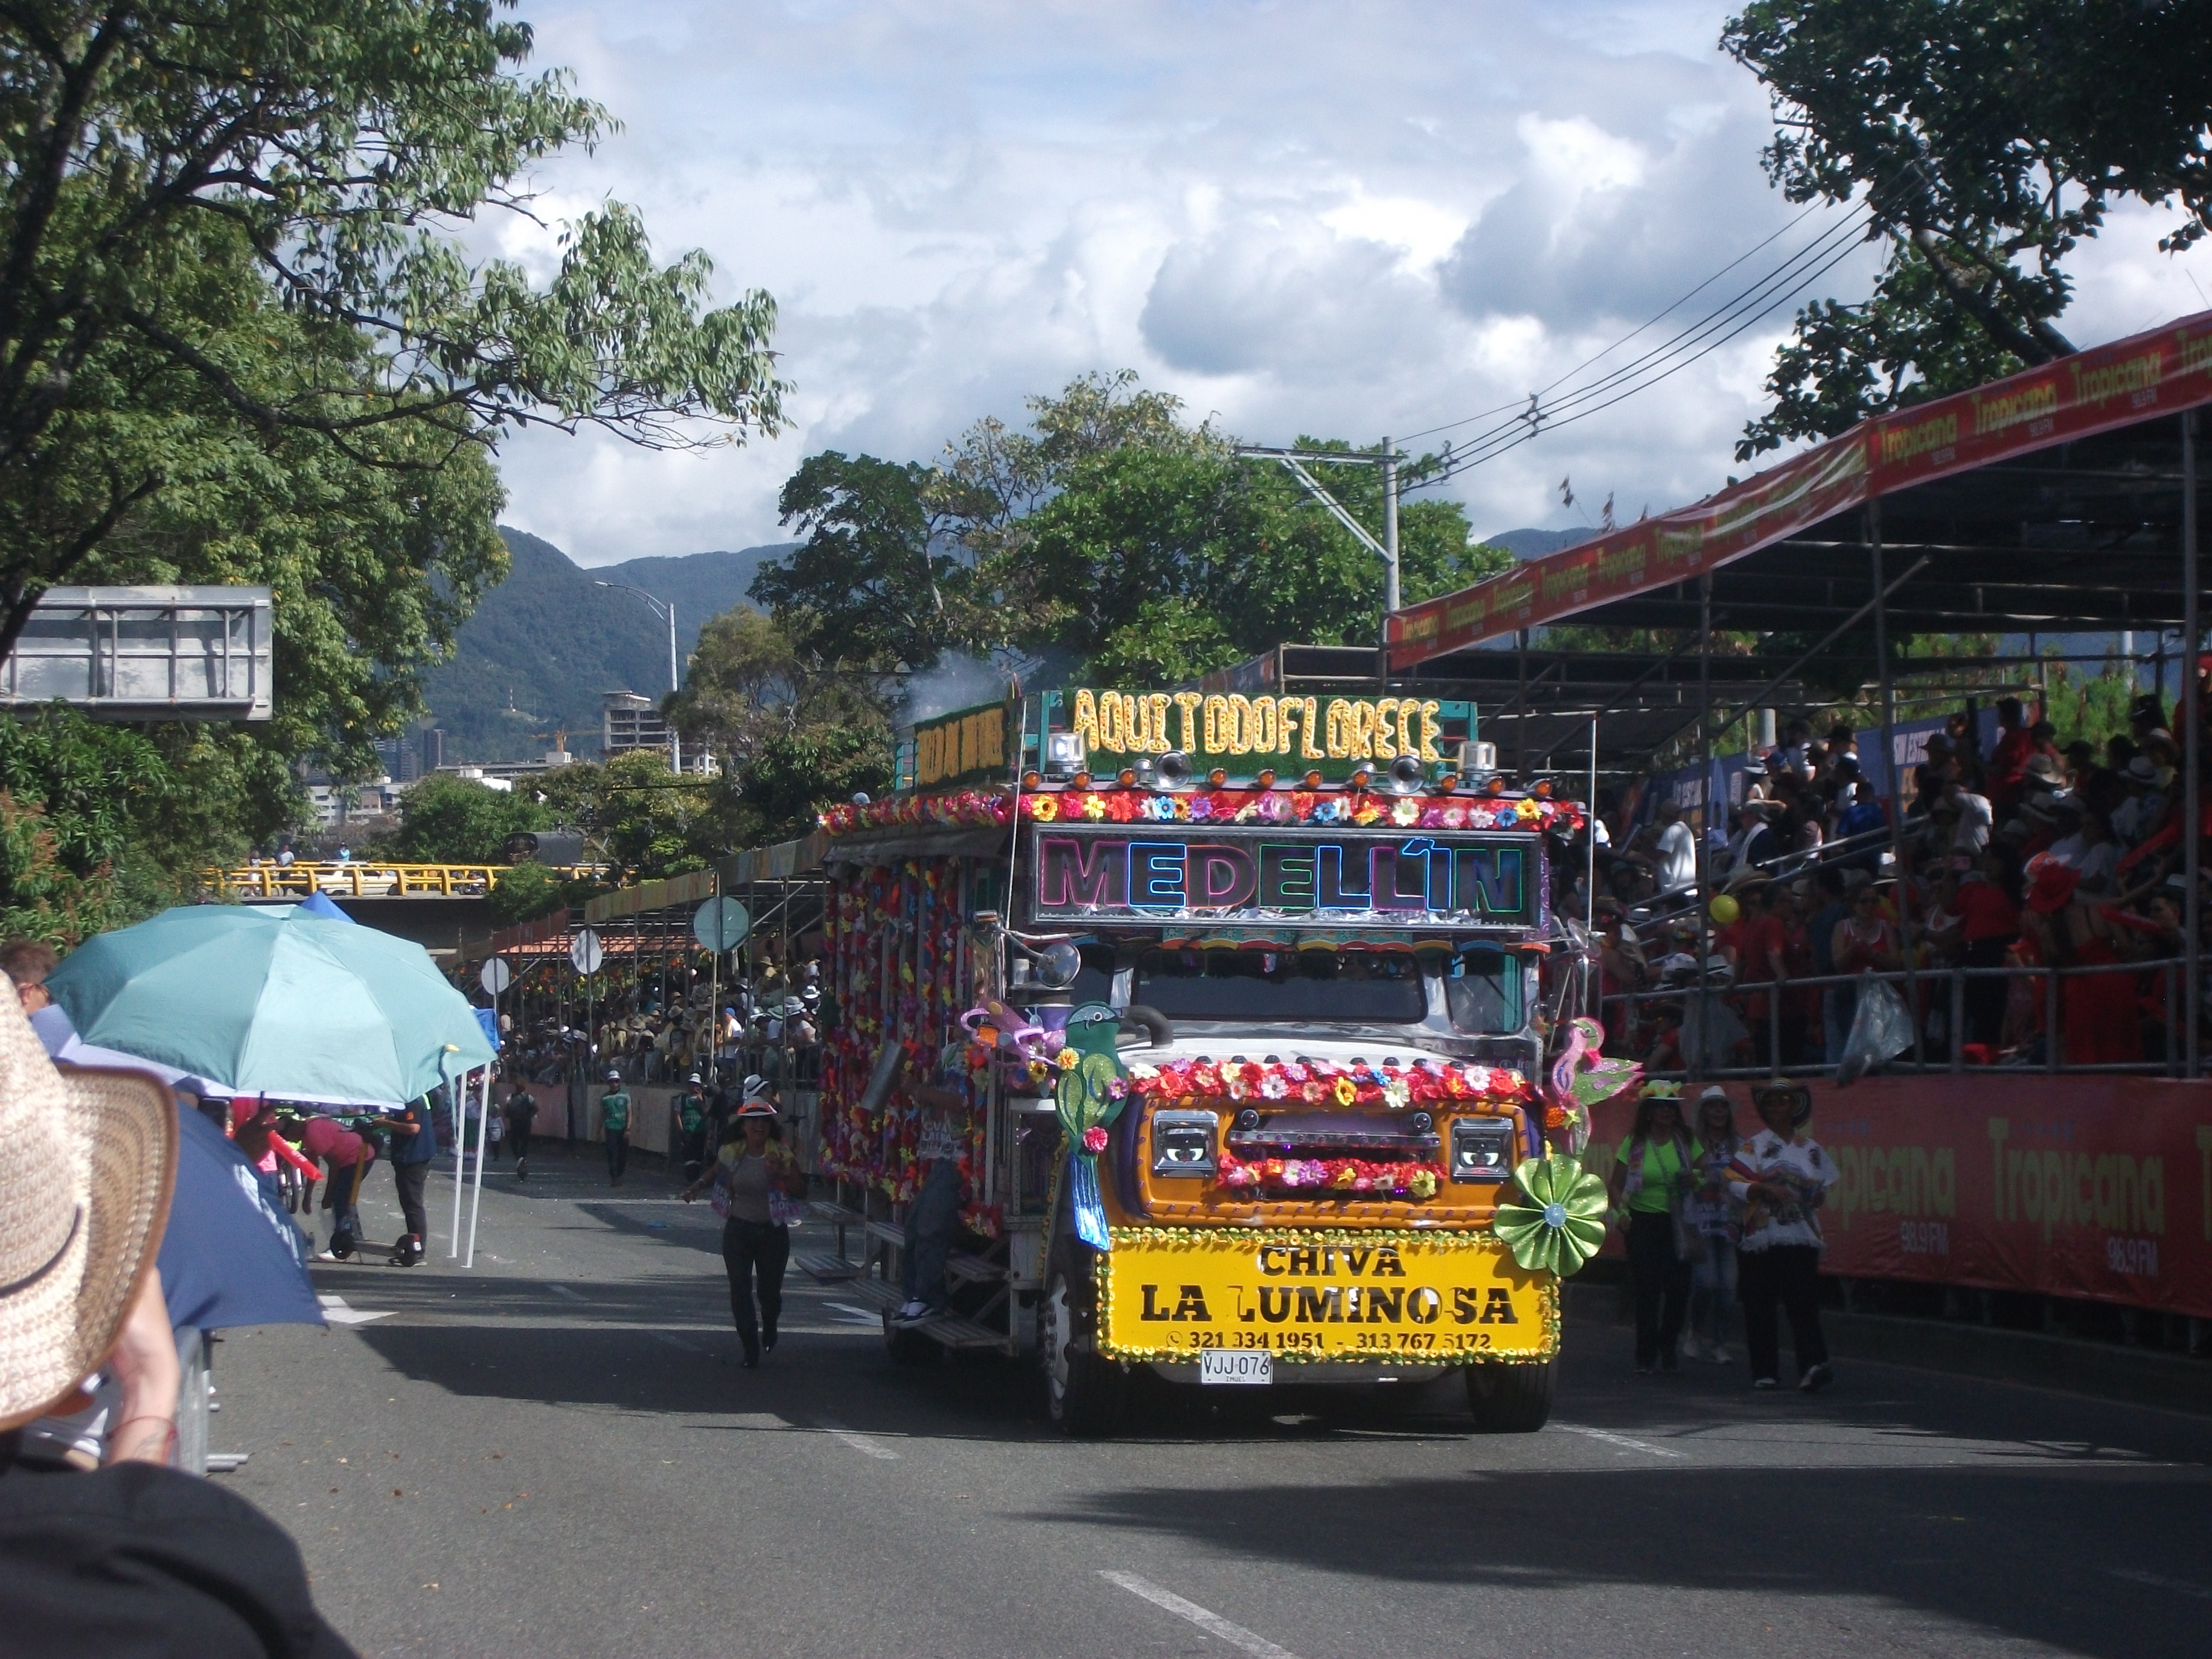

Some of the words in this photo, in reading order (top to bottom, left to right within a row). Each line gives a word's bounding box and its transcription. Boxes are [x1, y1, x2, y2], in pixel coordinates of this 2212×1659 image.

[2070, 351, 2161, 409] Tropicana
[1971, 383, 2057, 438] Tropicana
[1877, 412, 1957, 466] Tropicana
[1041, 838, 1523, 912] MEDELLÍN
[1987, 1117, 2166, 1245] Tropicana
[1257, 1245, 1407, 1276] CHIVA
[1140, 1284, 1213, 1322] LA
[1189, 1332, 1224, 1349] 321
[1276, 1332, 1324, 1349] 1951
[1356, 1332, 1391, 1349] 313
[1396, 1332, 1436, 1350] 767
